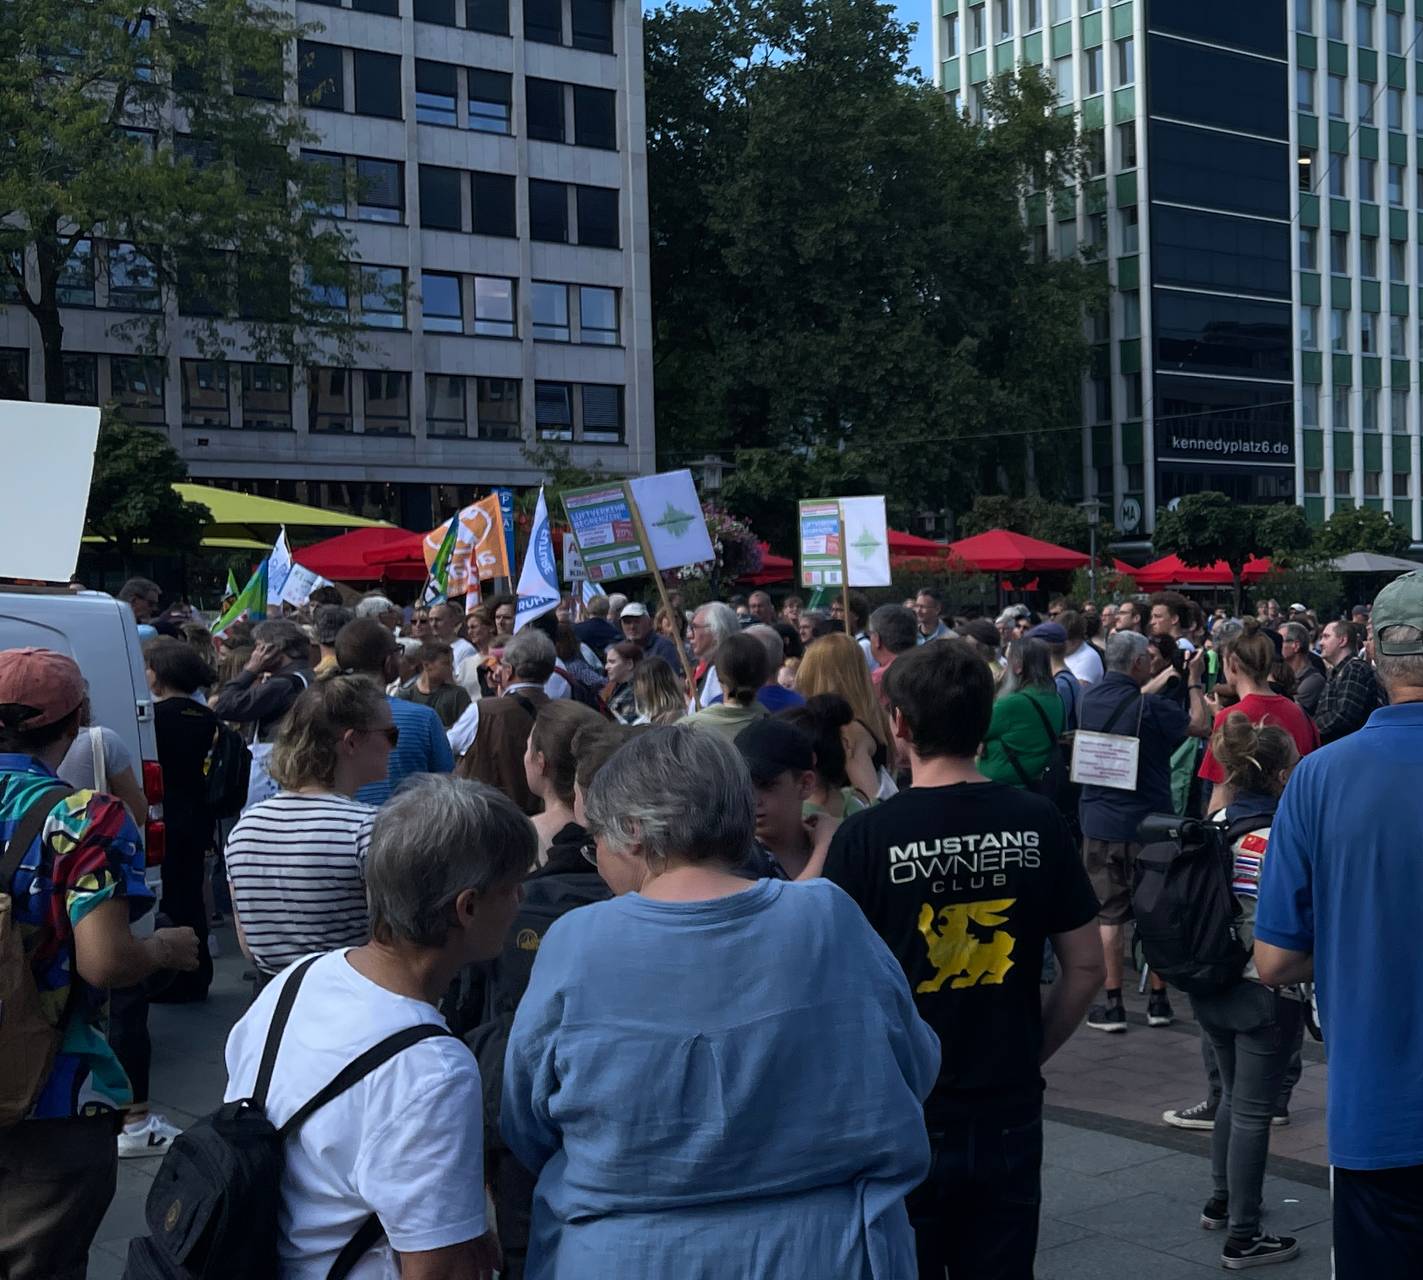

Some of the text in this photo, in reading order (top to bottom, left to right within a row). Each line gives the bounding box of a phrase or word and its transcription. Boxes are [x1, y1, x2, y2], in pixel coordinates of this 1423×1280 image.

[1172, 436, 1290, 455] kennedyplatz6.de
[889, 831, 1041, 864] MUSTANG
[889, 848, 1042, 884] OWNERS
[932, 873, 1008, 893] CLUB
